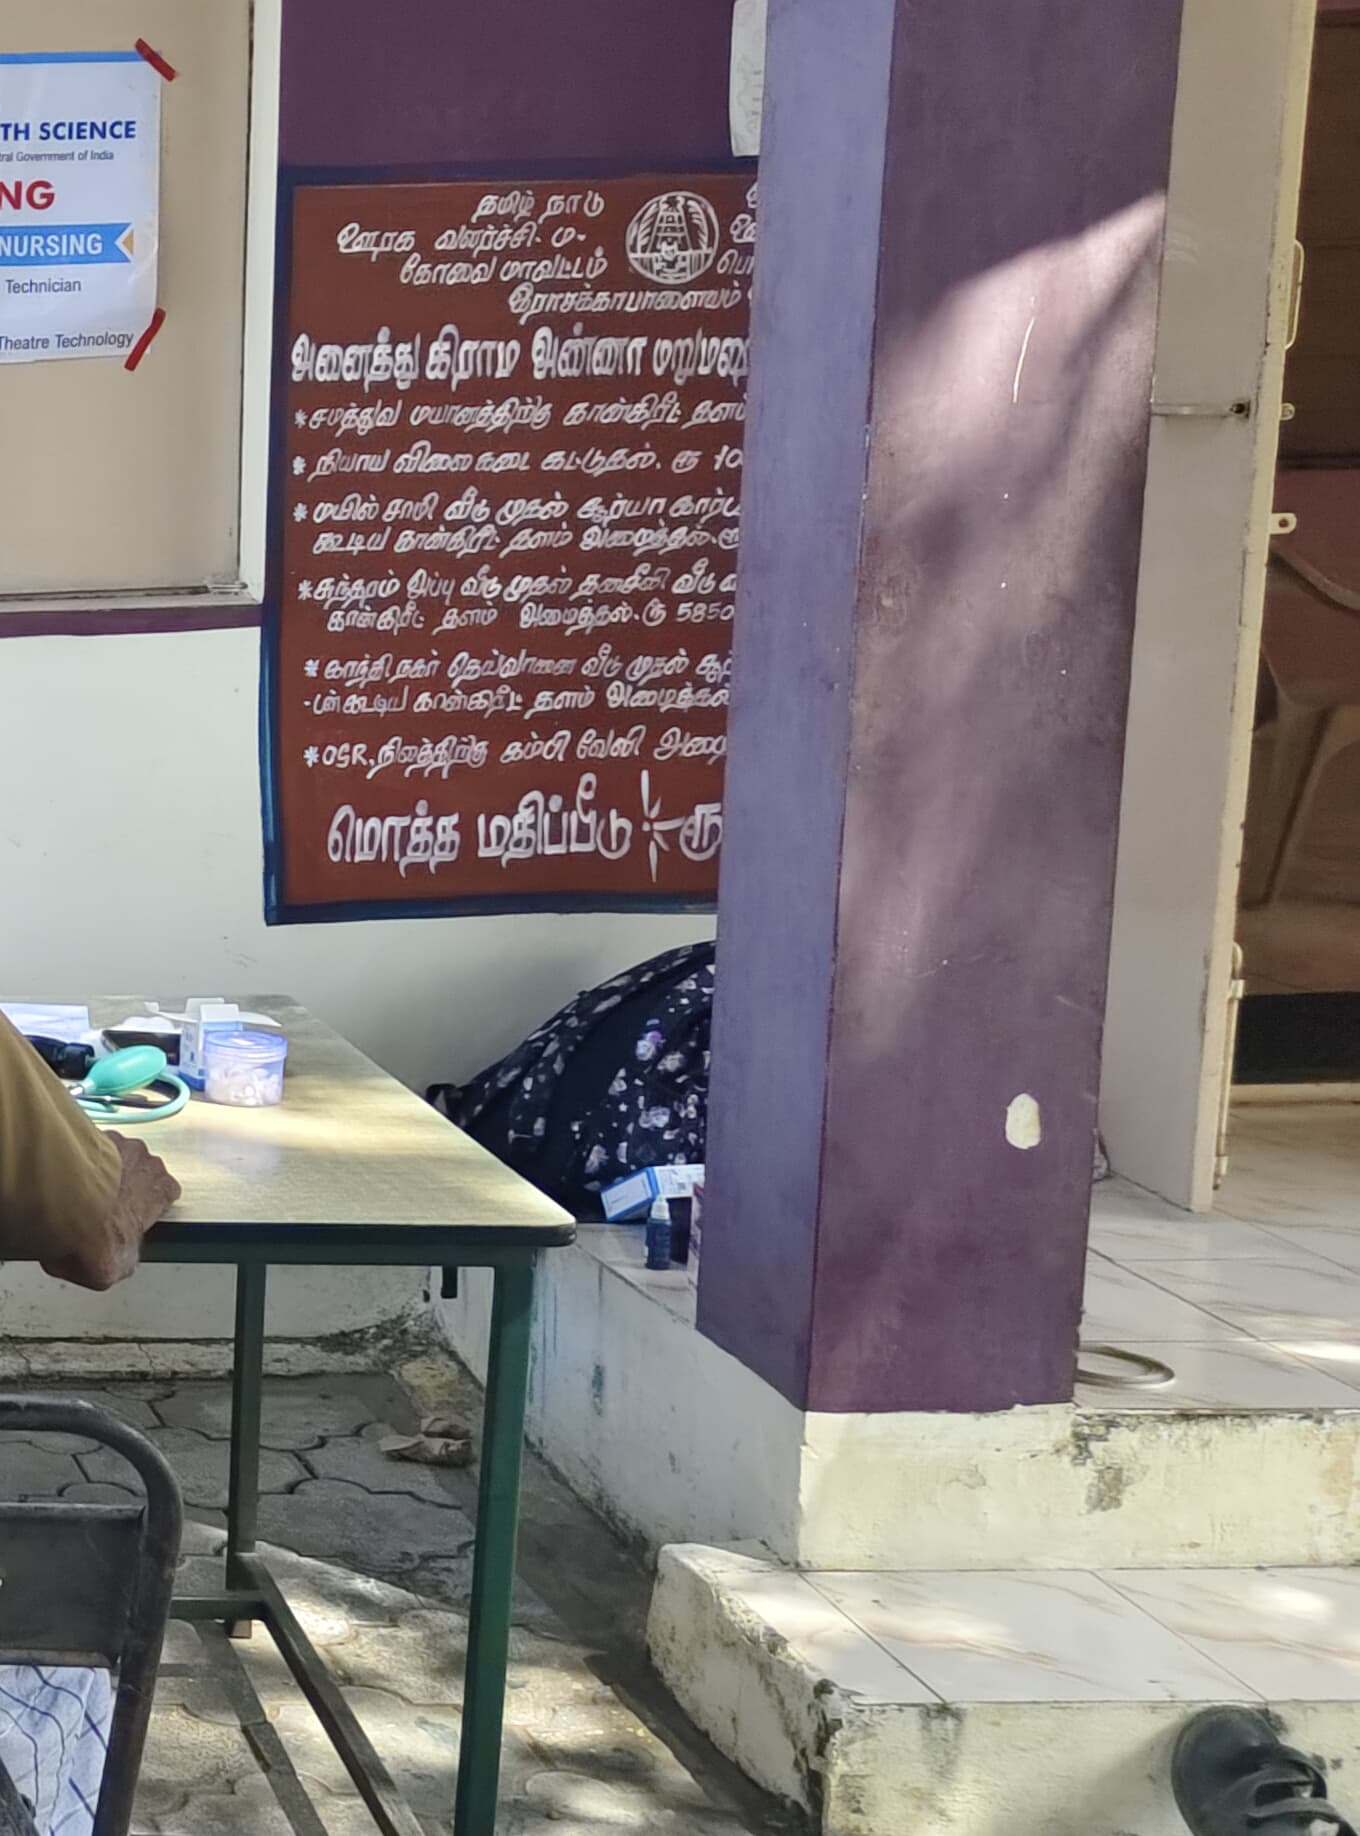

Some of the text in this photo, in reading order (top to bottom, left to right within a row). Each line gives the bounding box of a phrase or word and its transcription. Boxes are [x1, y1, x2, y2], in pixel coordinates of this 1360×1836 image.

[39, 120, 137, 141] SCIENCE
[16, 150, 75, 163] Government
[77, 150, 88, 161] of
[90, 149, 114, 161] India
[5, 278, 81, 294] Technician
[55, 330, 134, 350] Technology
[425, 323, 521, 392] கிராம
[327, 799, 462, 879] மொத்த
